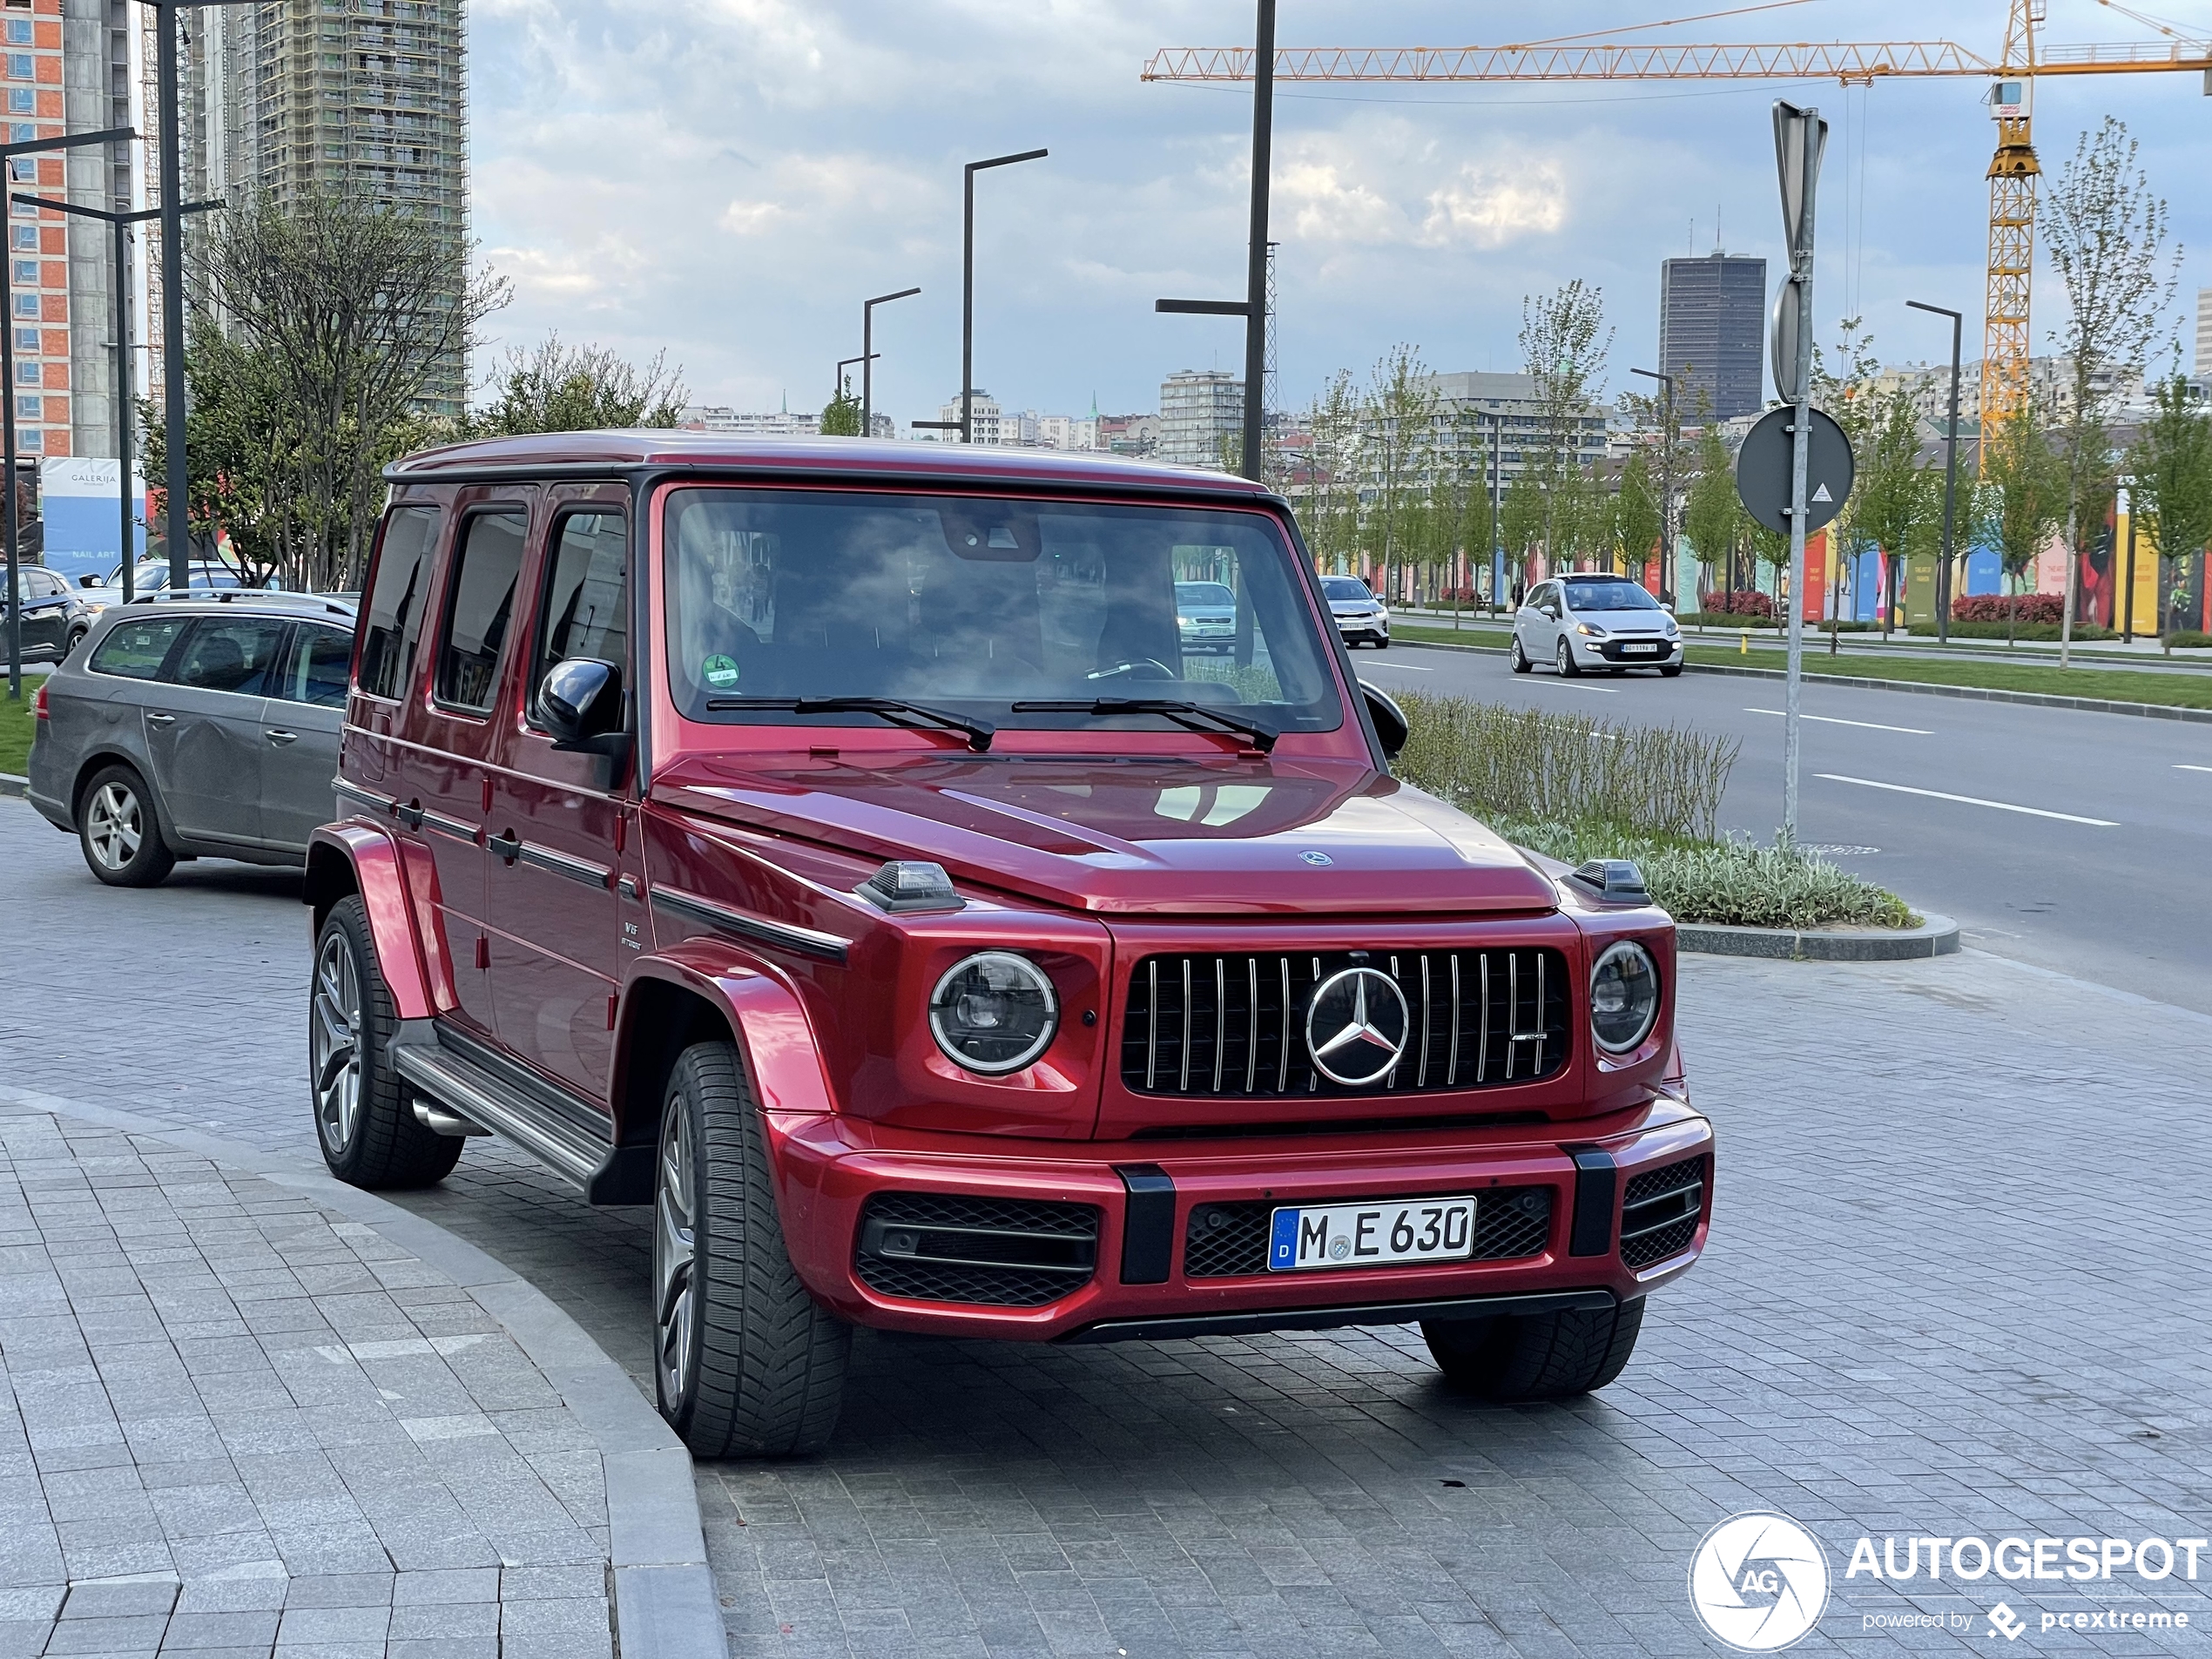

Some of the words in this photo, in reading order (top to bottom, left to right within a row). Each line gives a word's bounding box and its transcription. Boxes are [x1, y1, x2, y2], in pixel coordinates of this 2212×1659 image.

[71, 475, 116, 483] GALERIJA
[715, 655, 725, 671] 4
[1278, 1244, 1290, 1258] D
[1299, 1215, 1329, 1260] M
[1353, 1211, 1381, 1257] E
[1390, 1206, 1468, 1253] 630
